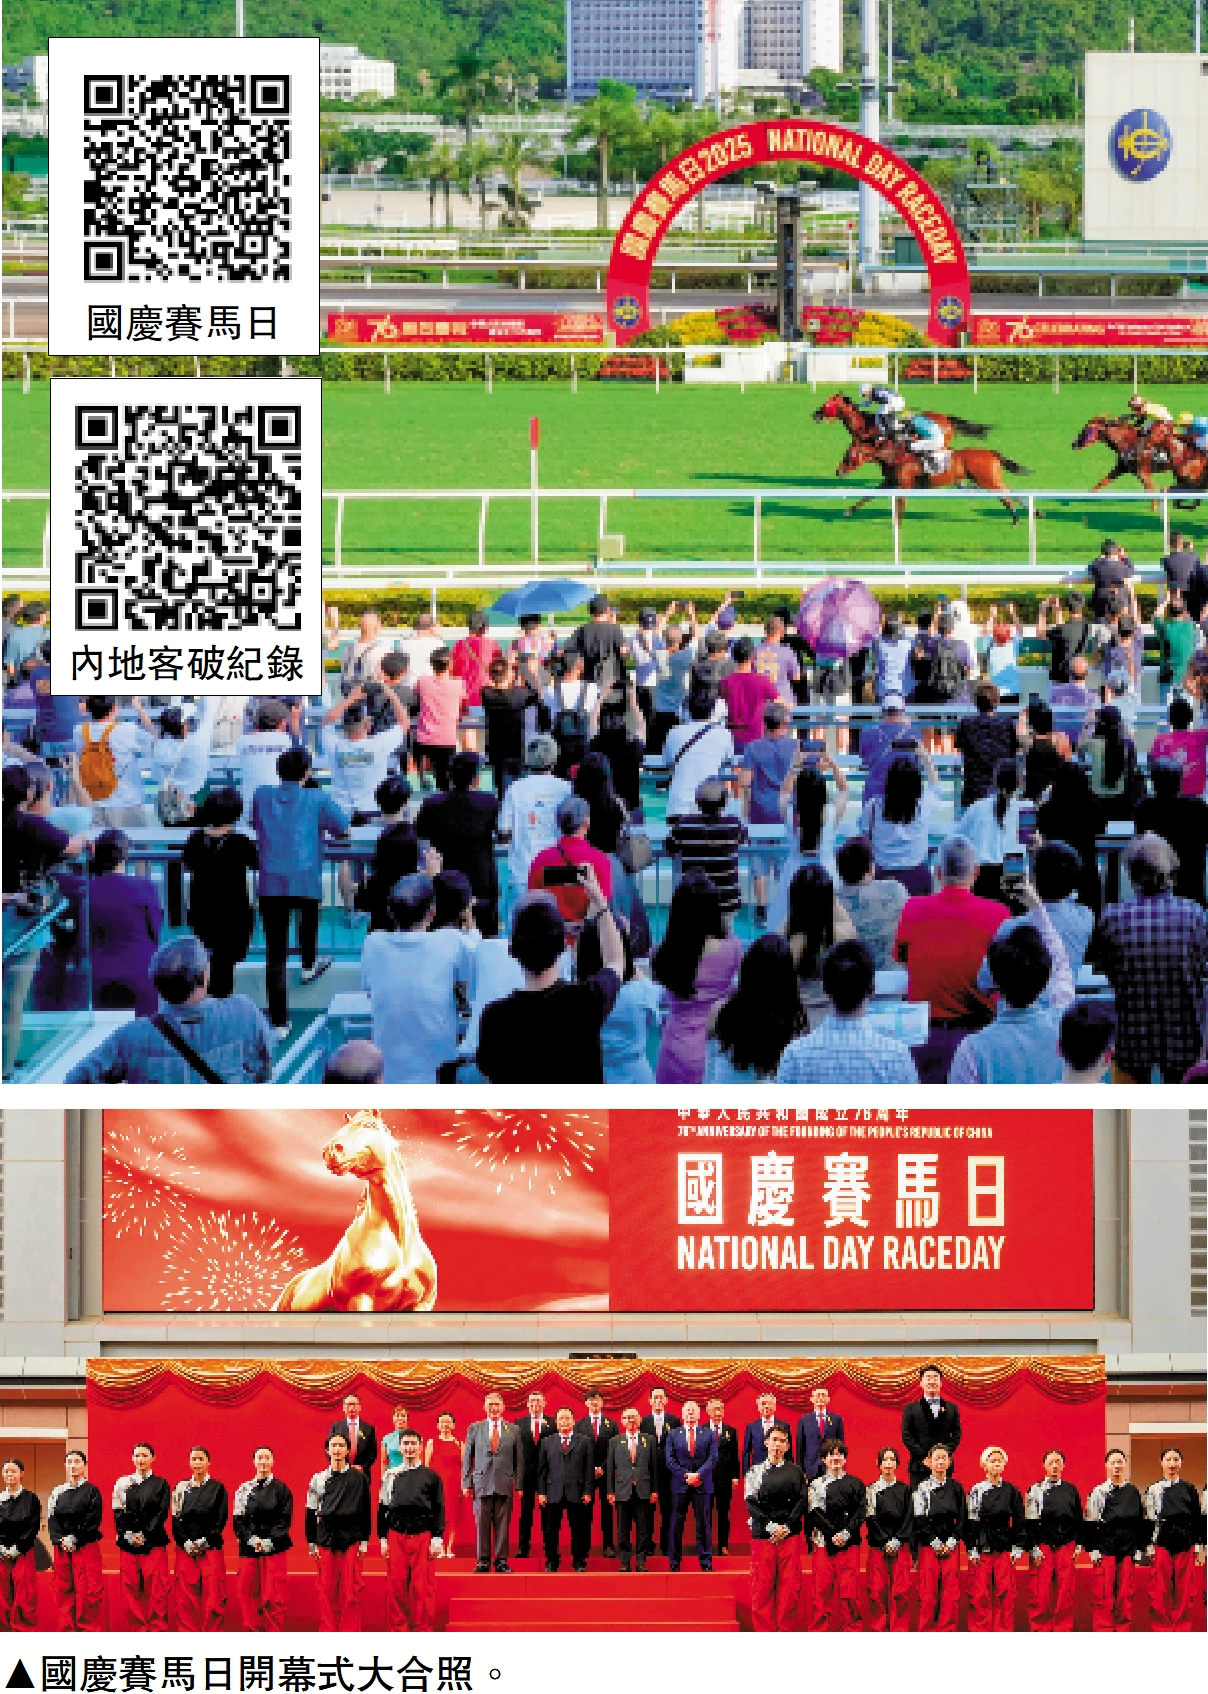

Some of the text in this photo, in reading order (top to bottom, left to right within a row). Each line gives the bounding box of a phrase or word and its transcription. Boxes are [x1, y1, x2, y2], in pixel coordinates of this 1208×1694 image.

[768, 128, 958, 264] NATIONAL DAY RACEDAY
[678, 1150, 1004, 1228] 國慶賽馬日
[678, 1236, 1005, 1270] NATIONAL DAY RACEDAY
